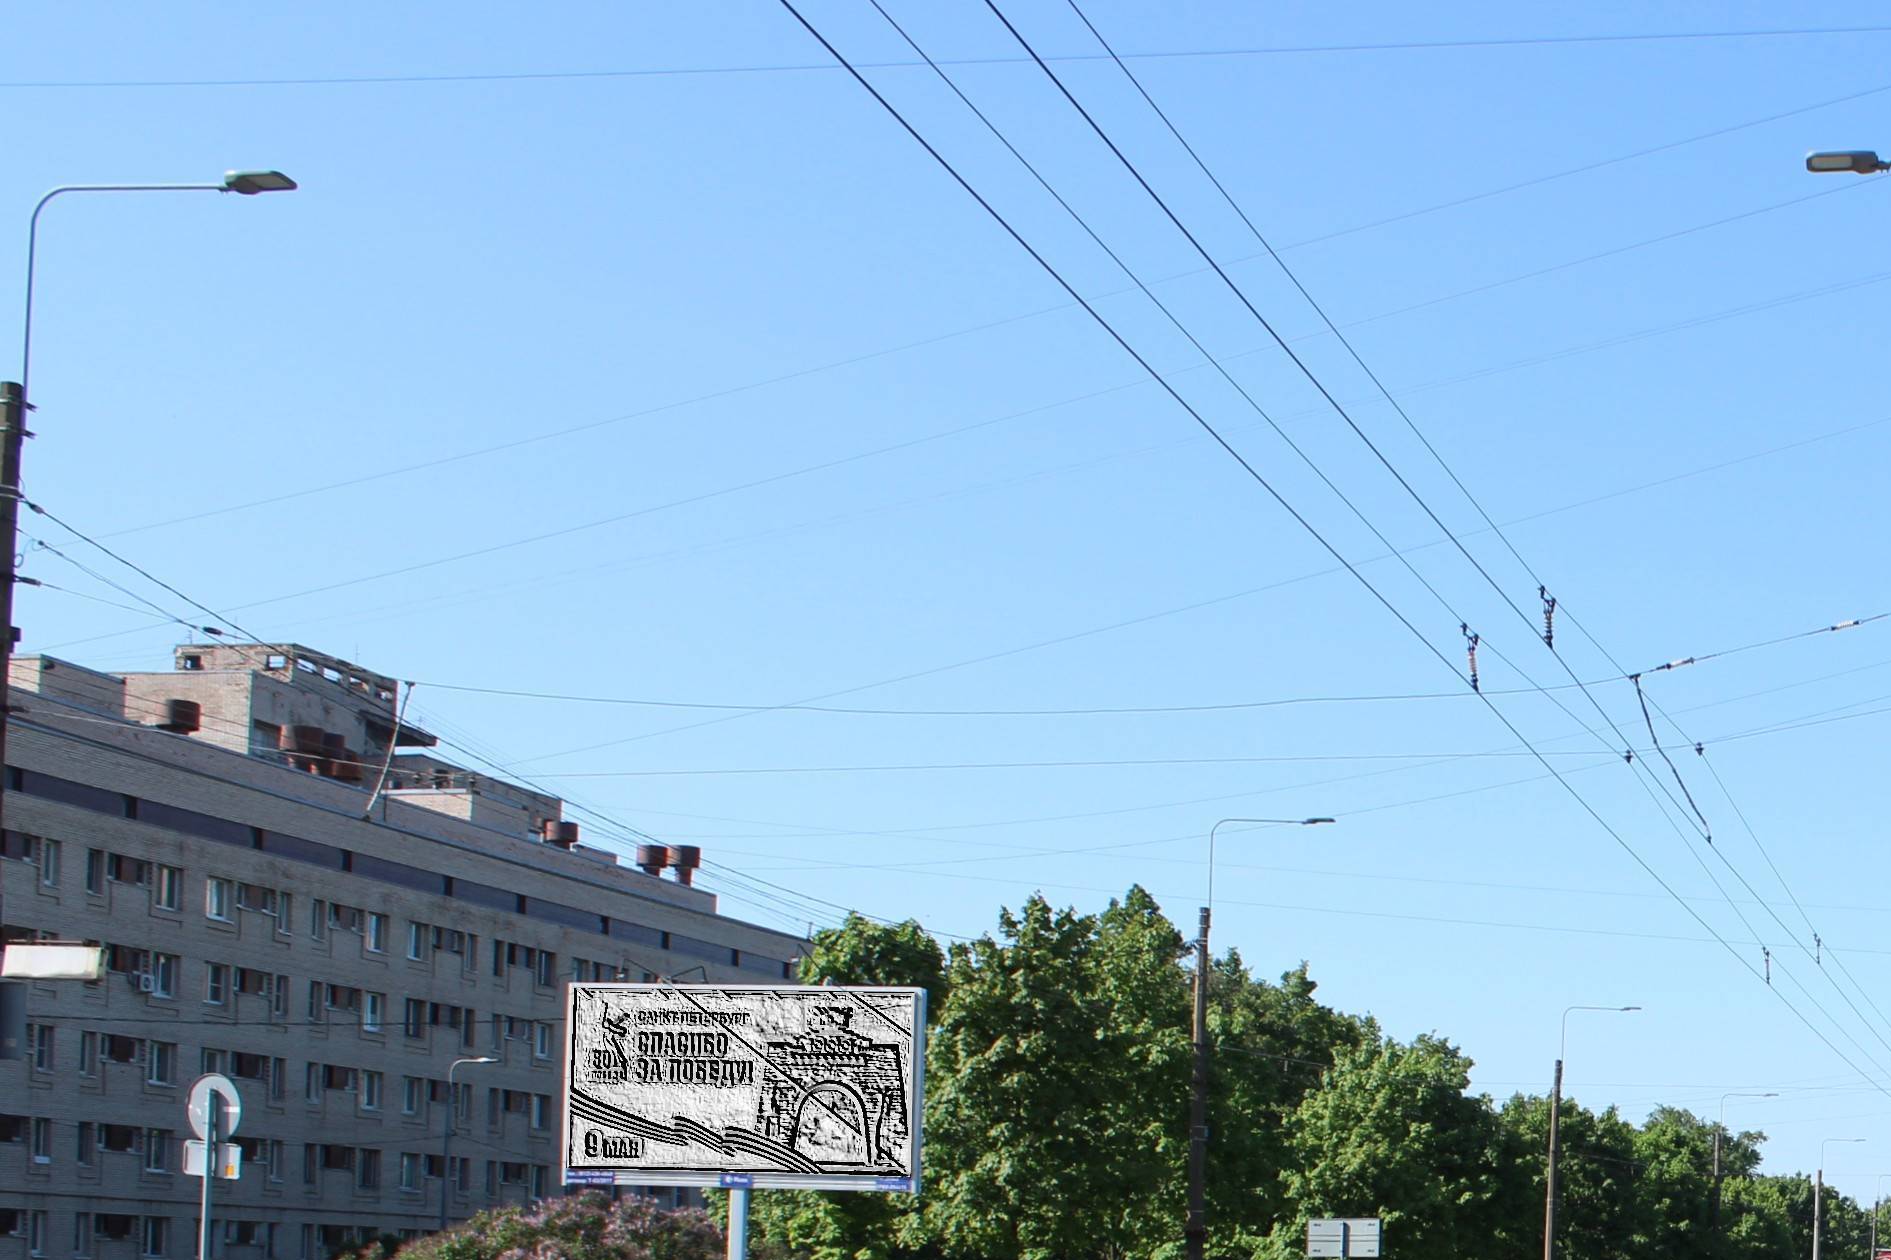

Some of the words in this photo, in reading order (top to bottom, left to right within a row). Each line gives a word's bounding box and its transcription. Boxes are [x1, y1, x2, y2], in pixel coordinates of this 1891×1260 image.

[635, 1031, 729, 1057] СПАСИБО
[634, 1058, 663, 1083] ЗА
[584, 1129, 603, 1158] 9
